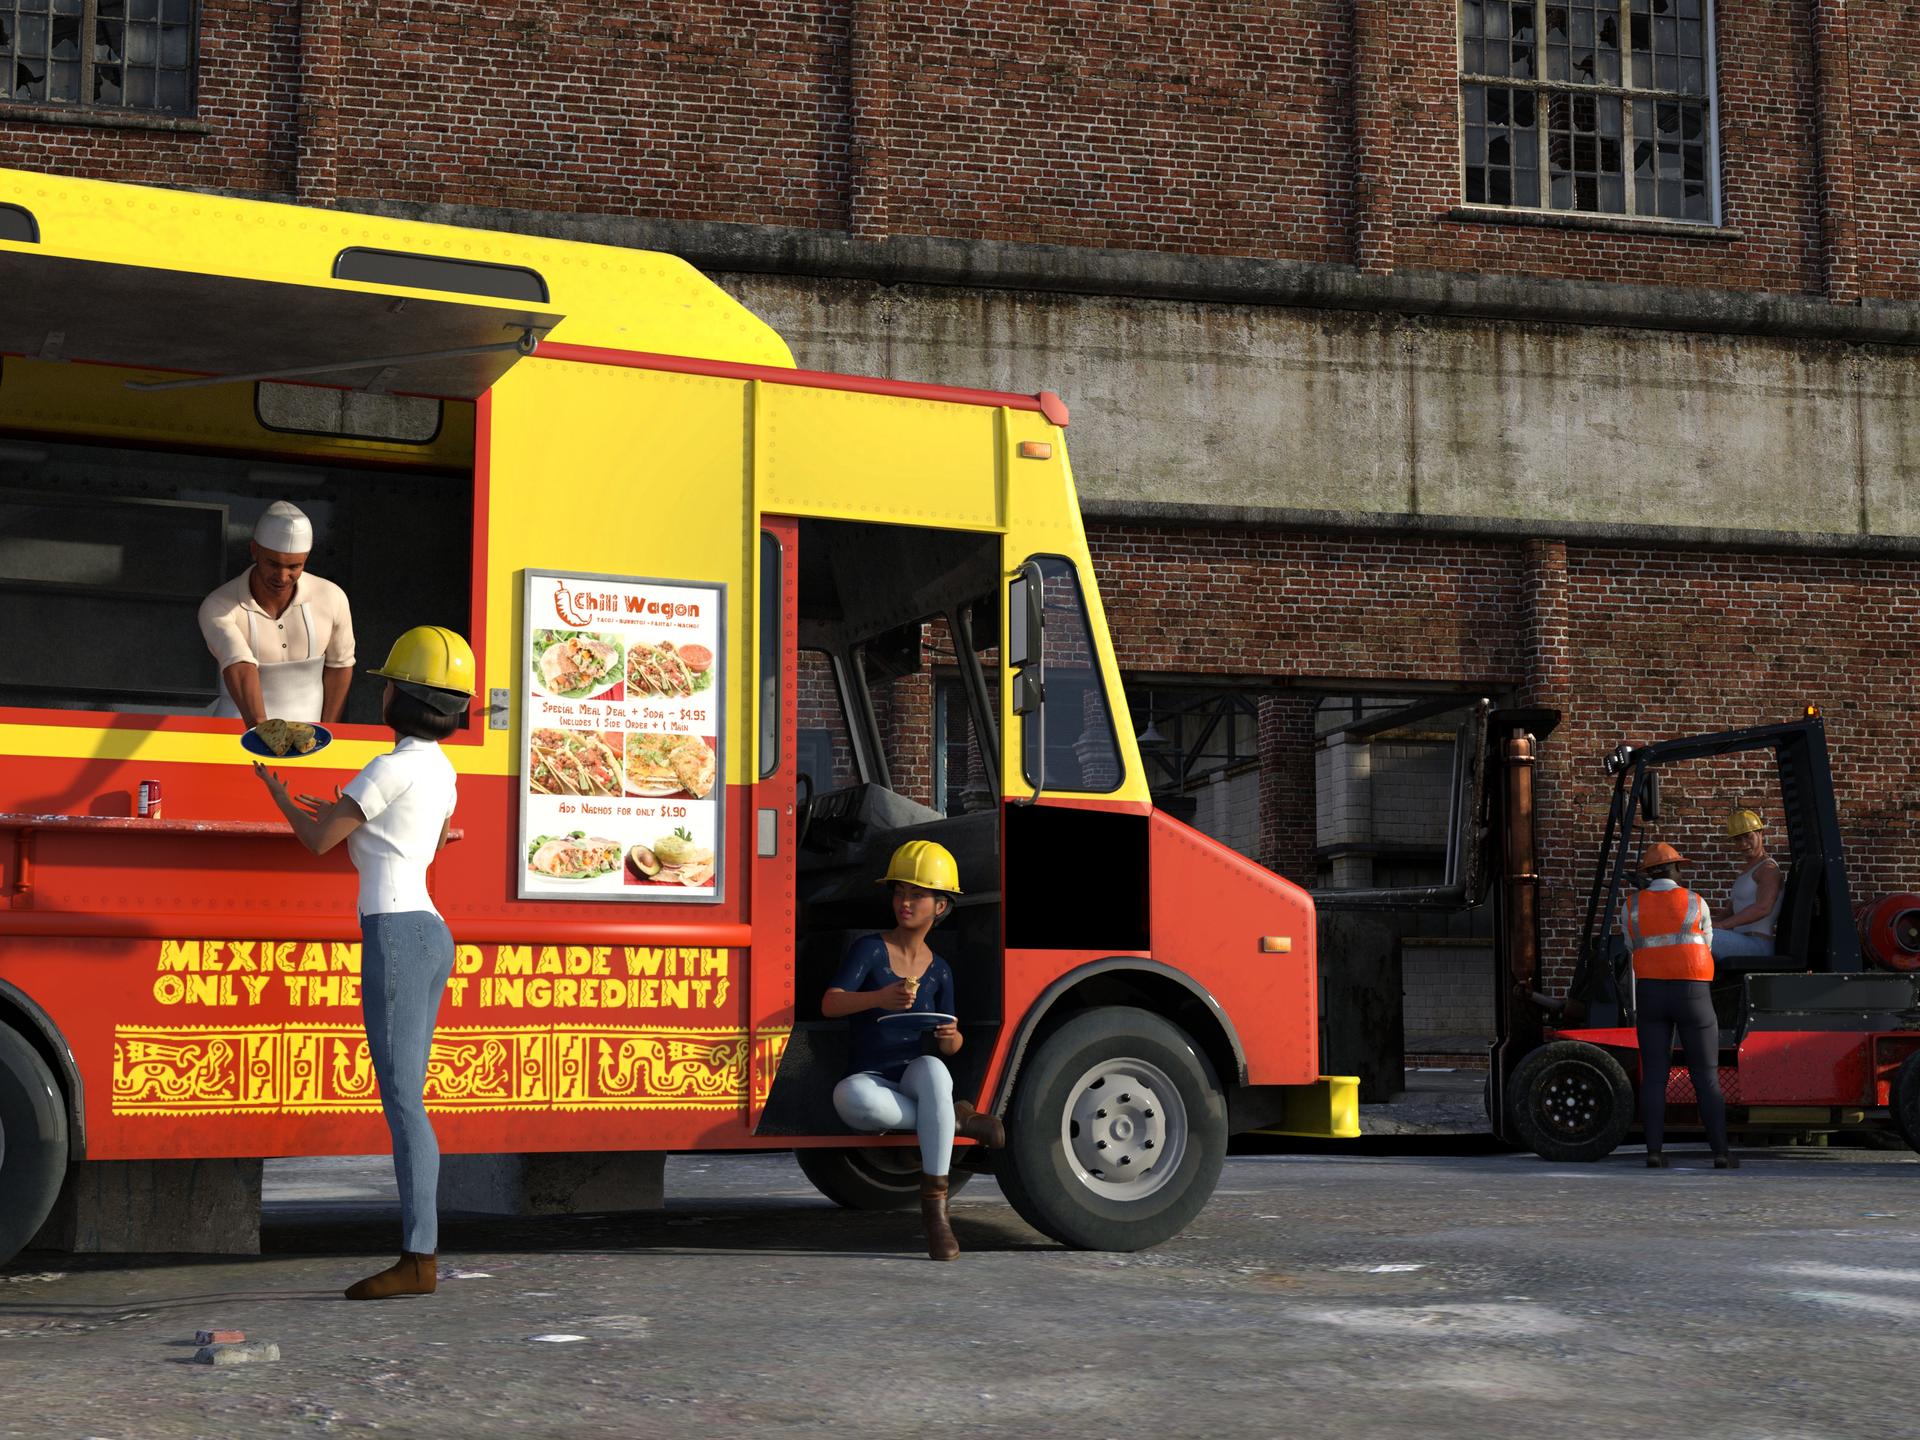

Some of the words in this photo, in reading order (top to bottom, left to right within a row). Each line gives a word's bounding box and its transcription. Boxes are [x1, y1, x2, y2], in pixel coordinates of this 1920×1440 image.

[574, 592, 618, 613] Chili
[624, 595, 700, 620] Wagon
[542, 701, 574, 715] SPECIAL
[579, 703, 601, 716] MEAL
[606, 705, 626, 718] DEAL
[643, 707, 664, 720] SODA
[679, 708, 706, 721] $4.95
[604, 717, 621, 728] SIDE
[625, 719, 648, 730] ORDER
[670, 721, 689, 732] MAIN
[558, 801, 576, 814] ADD
[581, 803, 612, 815] NACHOS
[617, 807, 632, 816] FOR
[635, 808, 656, 817] ONLY
[157, 940, 362, 974] MEXICAN
[494, 945, 612, 976] MADE
[624, 947, 729, 977] WITH
[153, 974, 270, 1006] ONLY
[284, 975, 362, 1007] THE
[479, 973, 730, 1009] INGREDIENTS
